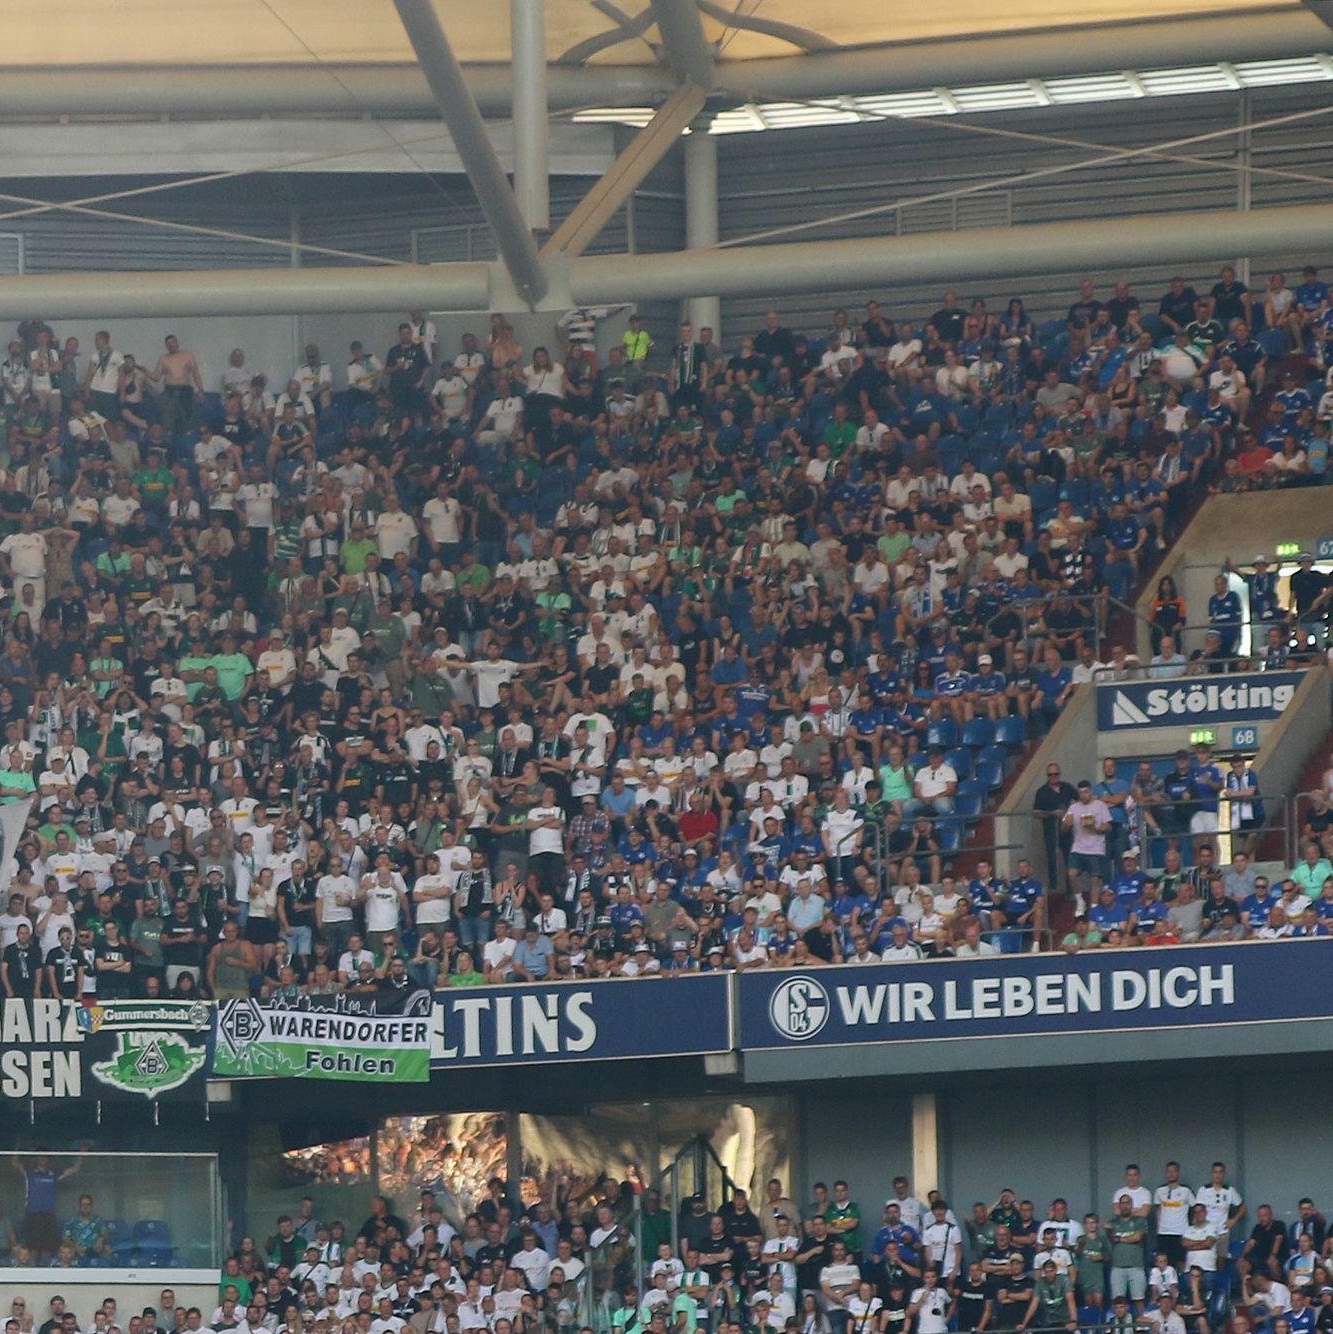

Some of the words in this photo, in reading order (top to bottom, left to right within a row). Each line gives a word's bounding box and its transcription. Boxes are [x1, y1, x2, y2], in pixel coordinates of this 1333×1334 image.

[1147, 681, 1295, 716] Stölting
[1236, 730, 1254, 745] 68
[837, 979, 934, 1026] WIR
[945, 973, 1102, 1021] LEBEN
[1113, 964, 1235, 1009] DICH
[104, 1005, 189, 1022] Gummersbach
[269, 1013, 428, 1042] WARENDORFER
[436, 991, 598, 1059] LTINS
[304, 1049, 395, 1075] Fohlen
